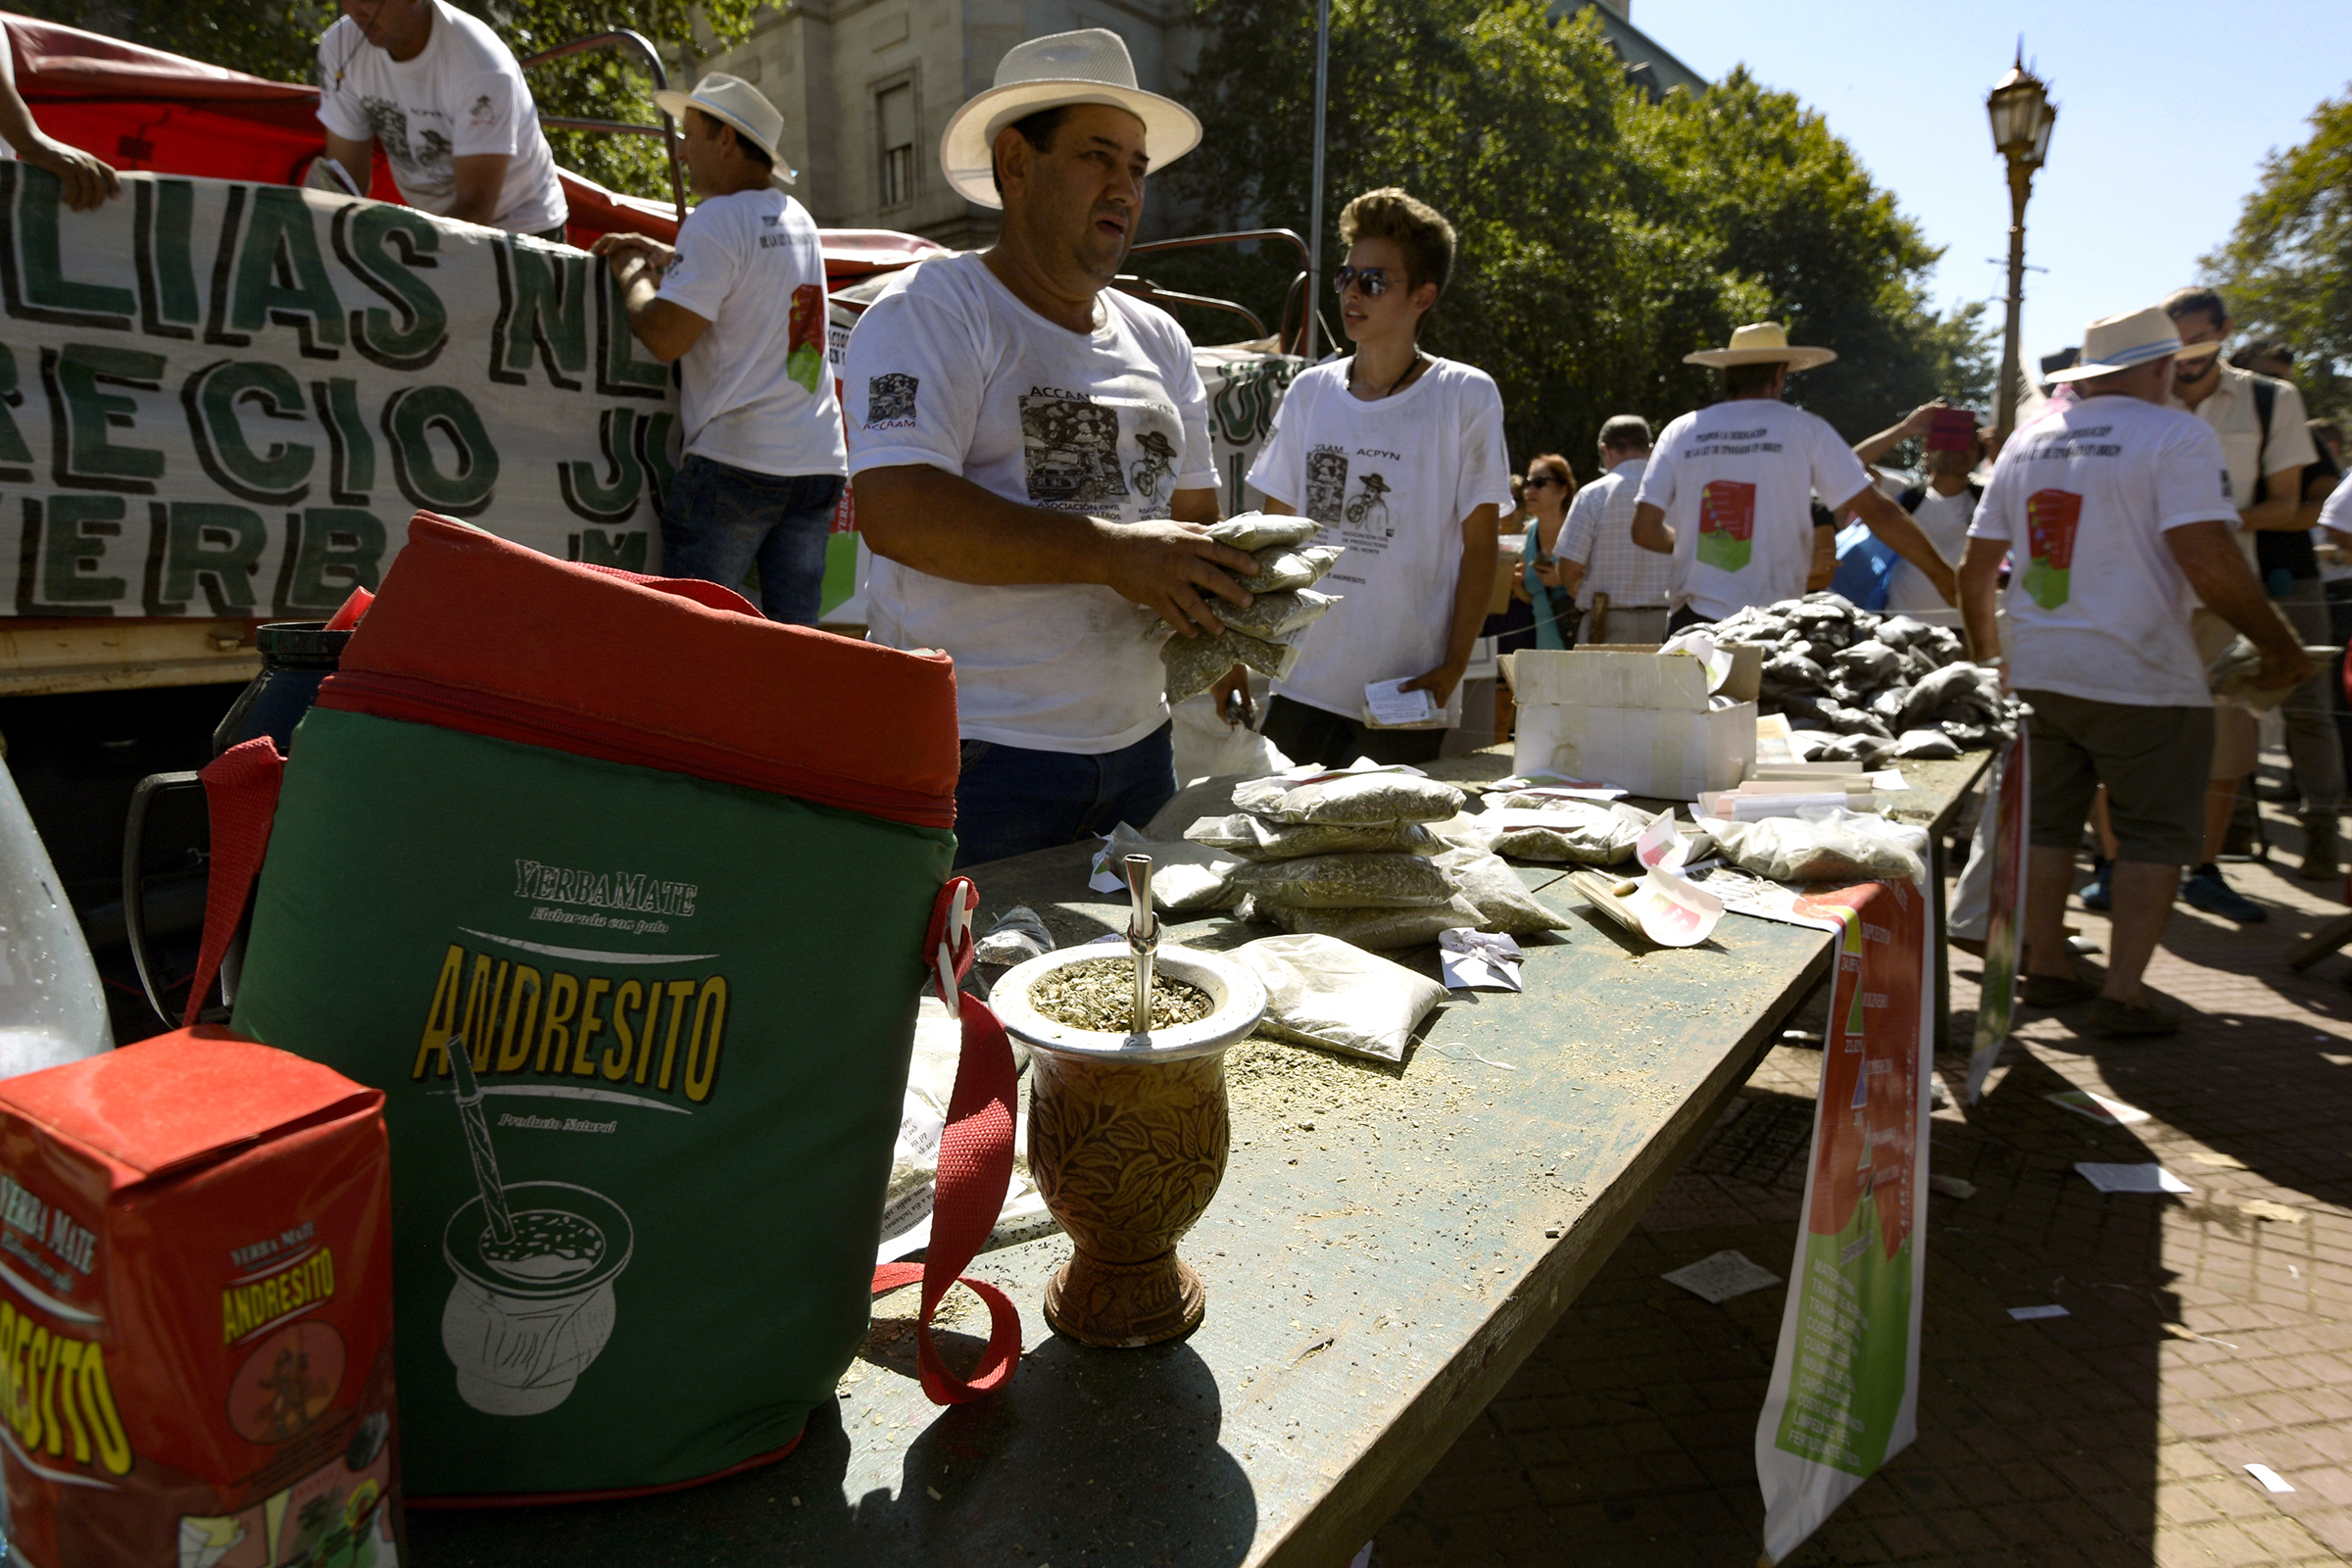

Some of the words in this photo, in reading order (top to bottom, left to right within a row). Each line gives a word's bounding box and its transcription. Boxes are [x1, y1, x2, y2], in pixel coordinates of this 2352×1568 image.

[862, 419, 915, 431] ACCAAM
[1356, 448, 1400, 461] ACPYN
[1333, 573, 1366, 585] ANDRESITO
[529, 906, 608, 928] Elaborada
[609, 917, 635, 930] con
[634, 918, 669, 935] palo
[411, 943, 729, 1103] ANDRESITO
[498, 1113, 563, 1130] Producto
[563, 1118, 617, 1134] Natural
[48, 1207, 97, 1275] MATE
[222, 1247, 335, 1346] ANDRESITO
